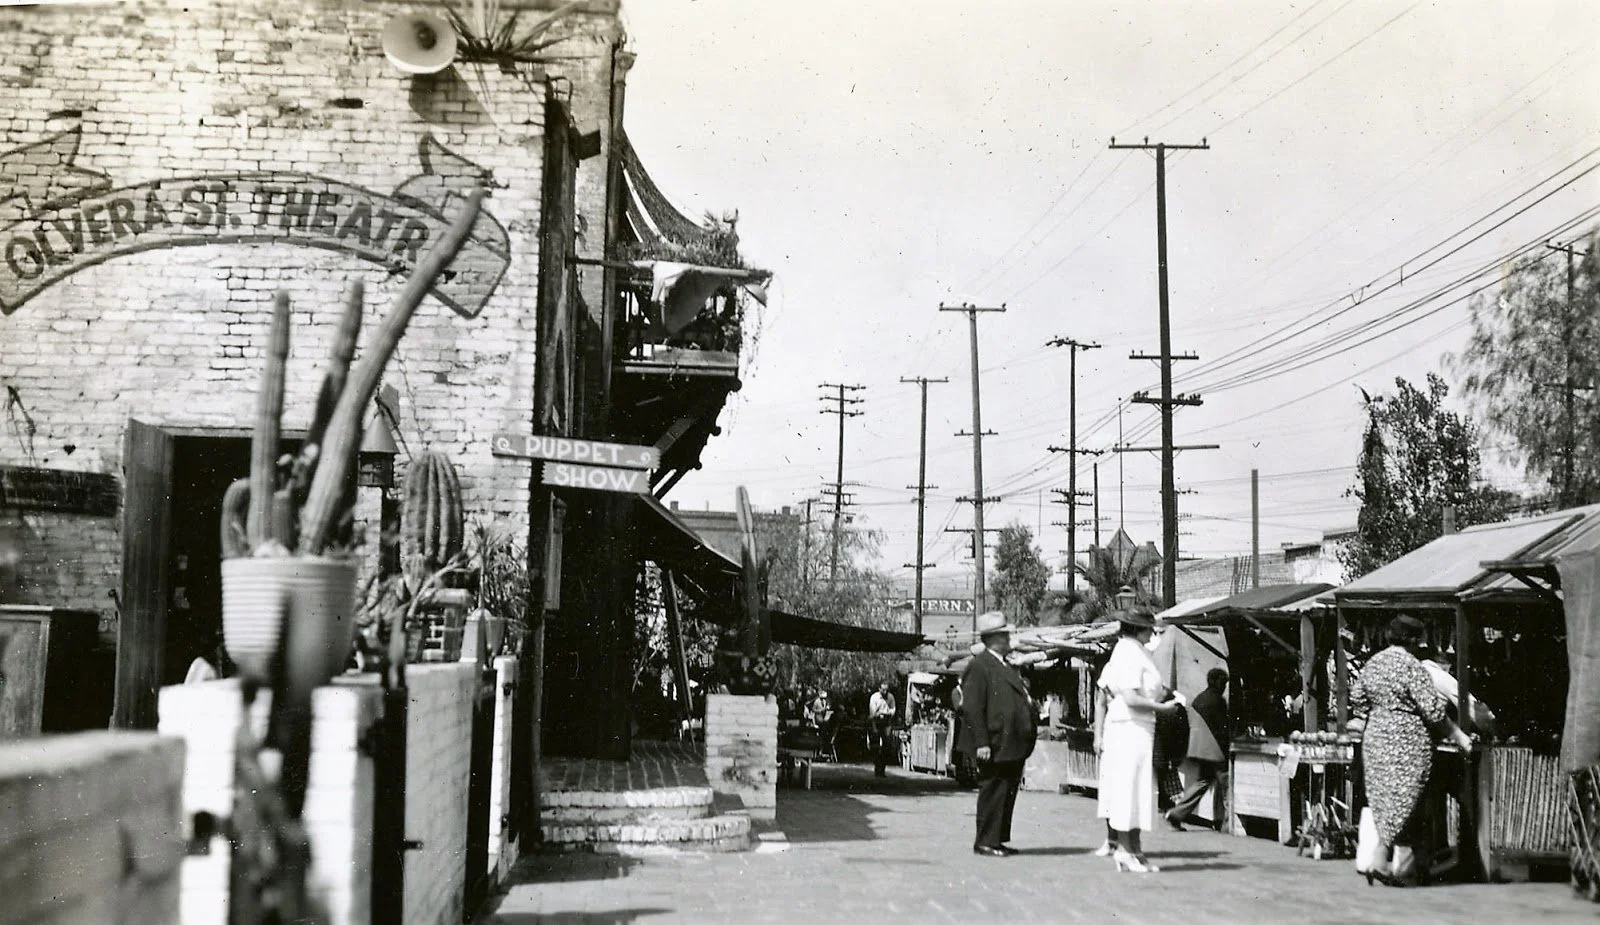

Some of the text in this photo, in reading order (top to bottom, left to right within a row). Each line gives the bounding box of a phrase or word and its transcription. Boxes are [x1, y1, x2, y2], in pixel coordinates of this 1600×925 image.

[5, 183, 430, 279] OLVERA ST. THEATR
[525, 435, 624, 464] PUPPET
[554, 465, 639, 491] SHOW
